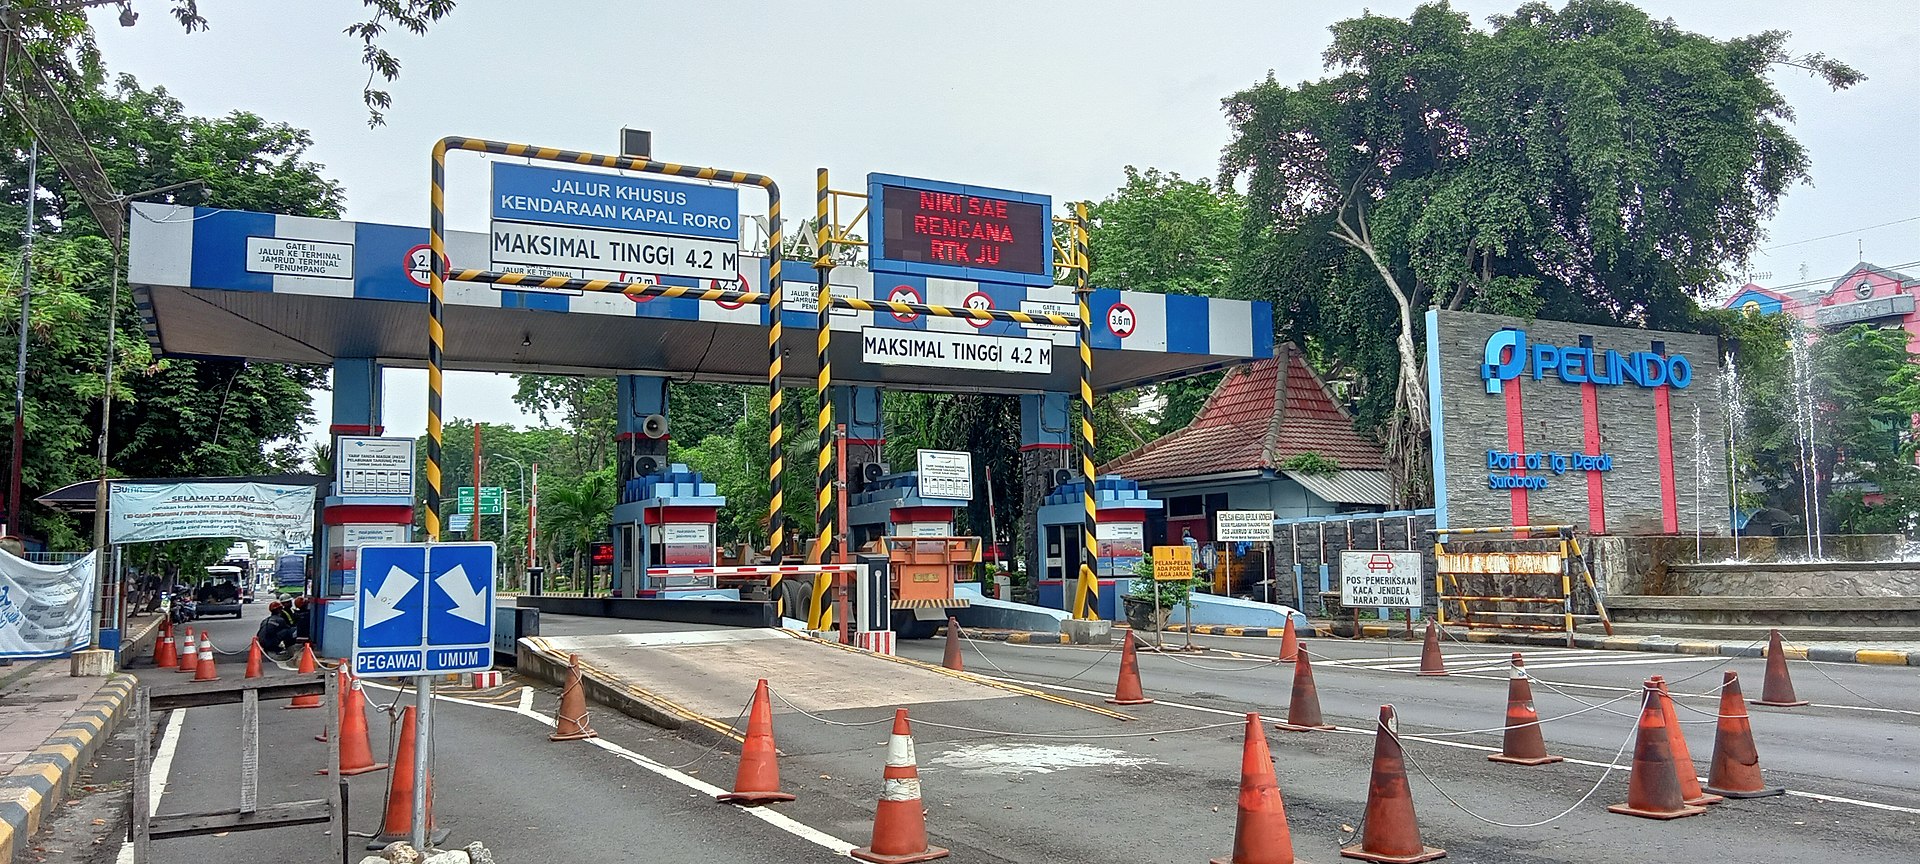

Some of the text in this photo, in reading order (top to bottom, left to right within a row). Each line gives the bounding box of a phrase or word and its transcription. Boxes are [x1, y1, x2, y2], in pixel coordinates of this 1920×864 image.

[552, 179, 687, 205] JALUR KHUSUS
[501, 195, 731, 230] KENDARAAN KAPAL RORO
[920, 191, 1009, 219] NIKI SAE
[914, 215, 1014, 243] RENCANA
[258, 248, 285, 256] JALUR
[301, 251, 342, 260] TERMINAL
[285, 243, 307, 251] GATE
[493, 232, 736, 271] MAKSIMAL TINGGI 4.2 M
[931, 239, 1000, 264] RTK JU
[260, 256, 339, 267] JAMRUD TERMINAL
[274, 264, 326, 273] PENUMPANG
[502, 266, 525, 274] JALUR
[539, 270, 574, 278] TERMINAL
[1111, 315, 1131, 326] 3.6 m
[864, 336, 1051, 365] MAKSIMAL TINGGI 4.2 M
[1531, 343, 1693, 389] PELINDO
[1488, 449, 1518, 470] Port
[1525, 450, 1543, 470] of
[1572, 451, 1614, 472] Perak
[1488, 473, 1549, 490] Surabaya
[1346, 576, 1417, 585] POS PEMERIKSAAN
[1352, 586, 1410, 595] KACA JENDELA
[1353, 596, 1410, 605] HARAP DIBUKA
[357, 651, 479, 670] PEGAWAI UMUM
